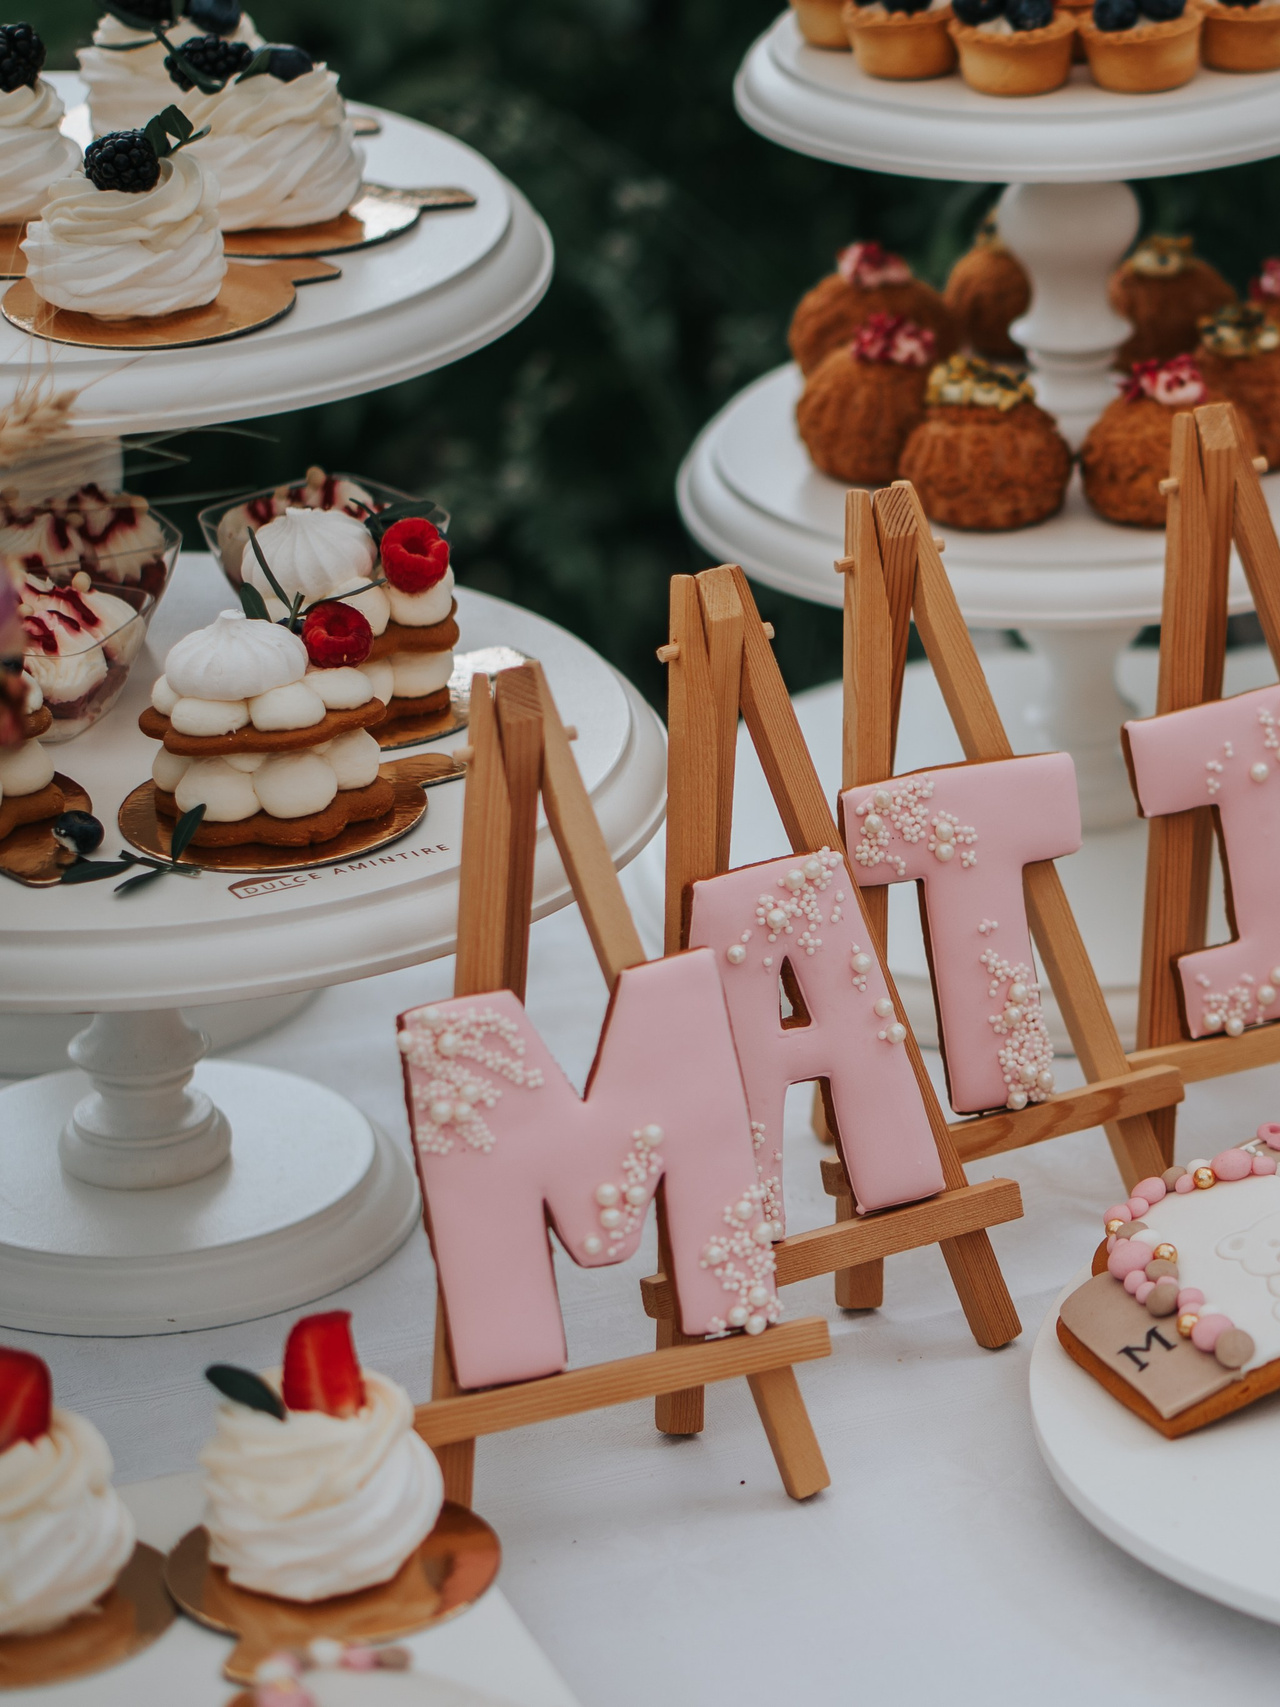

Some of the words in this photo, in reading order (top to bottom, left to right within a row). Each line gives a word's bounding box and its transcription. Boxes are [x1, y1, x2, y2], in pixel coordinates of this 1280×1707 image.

[243, 872, 322, 895] DULCE
[333, 843, 450, 875] AMINTIRE
[1117, 1326, 1178, 1372] M
